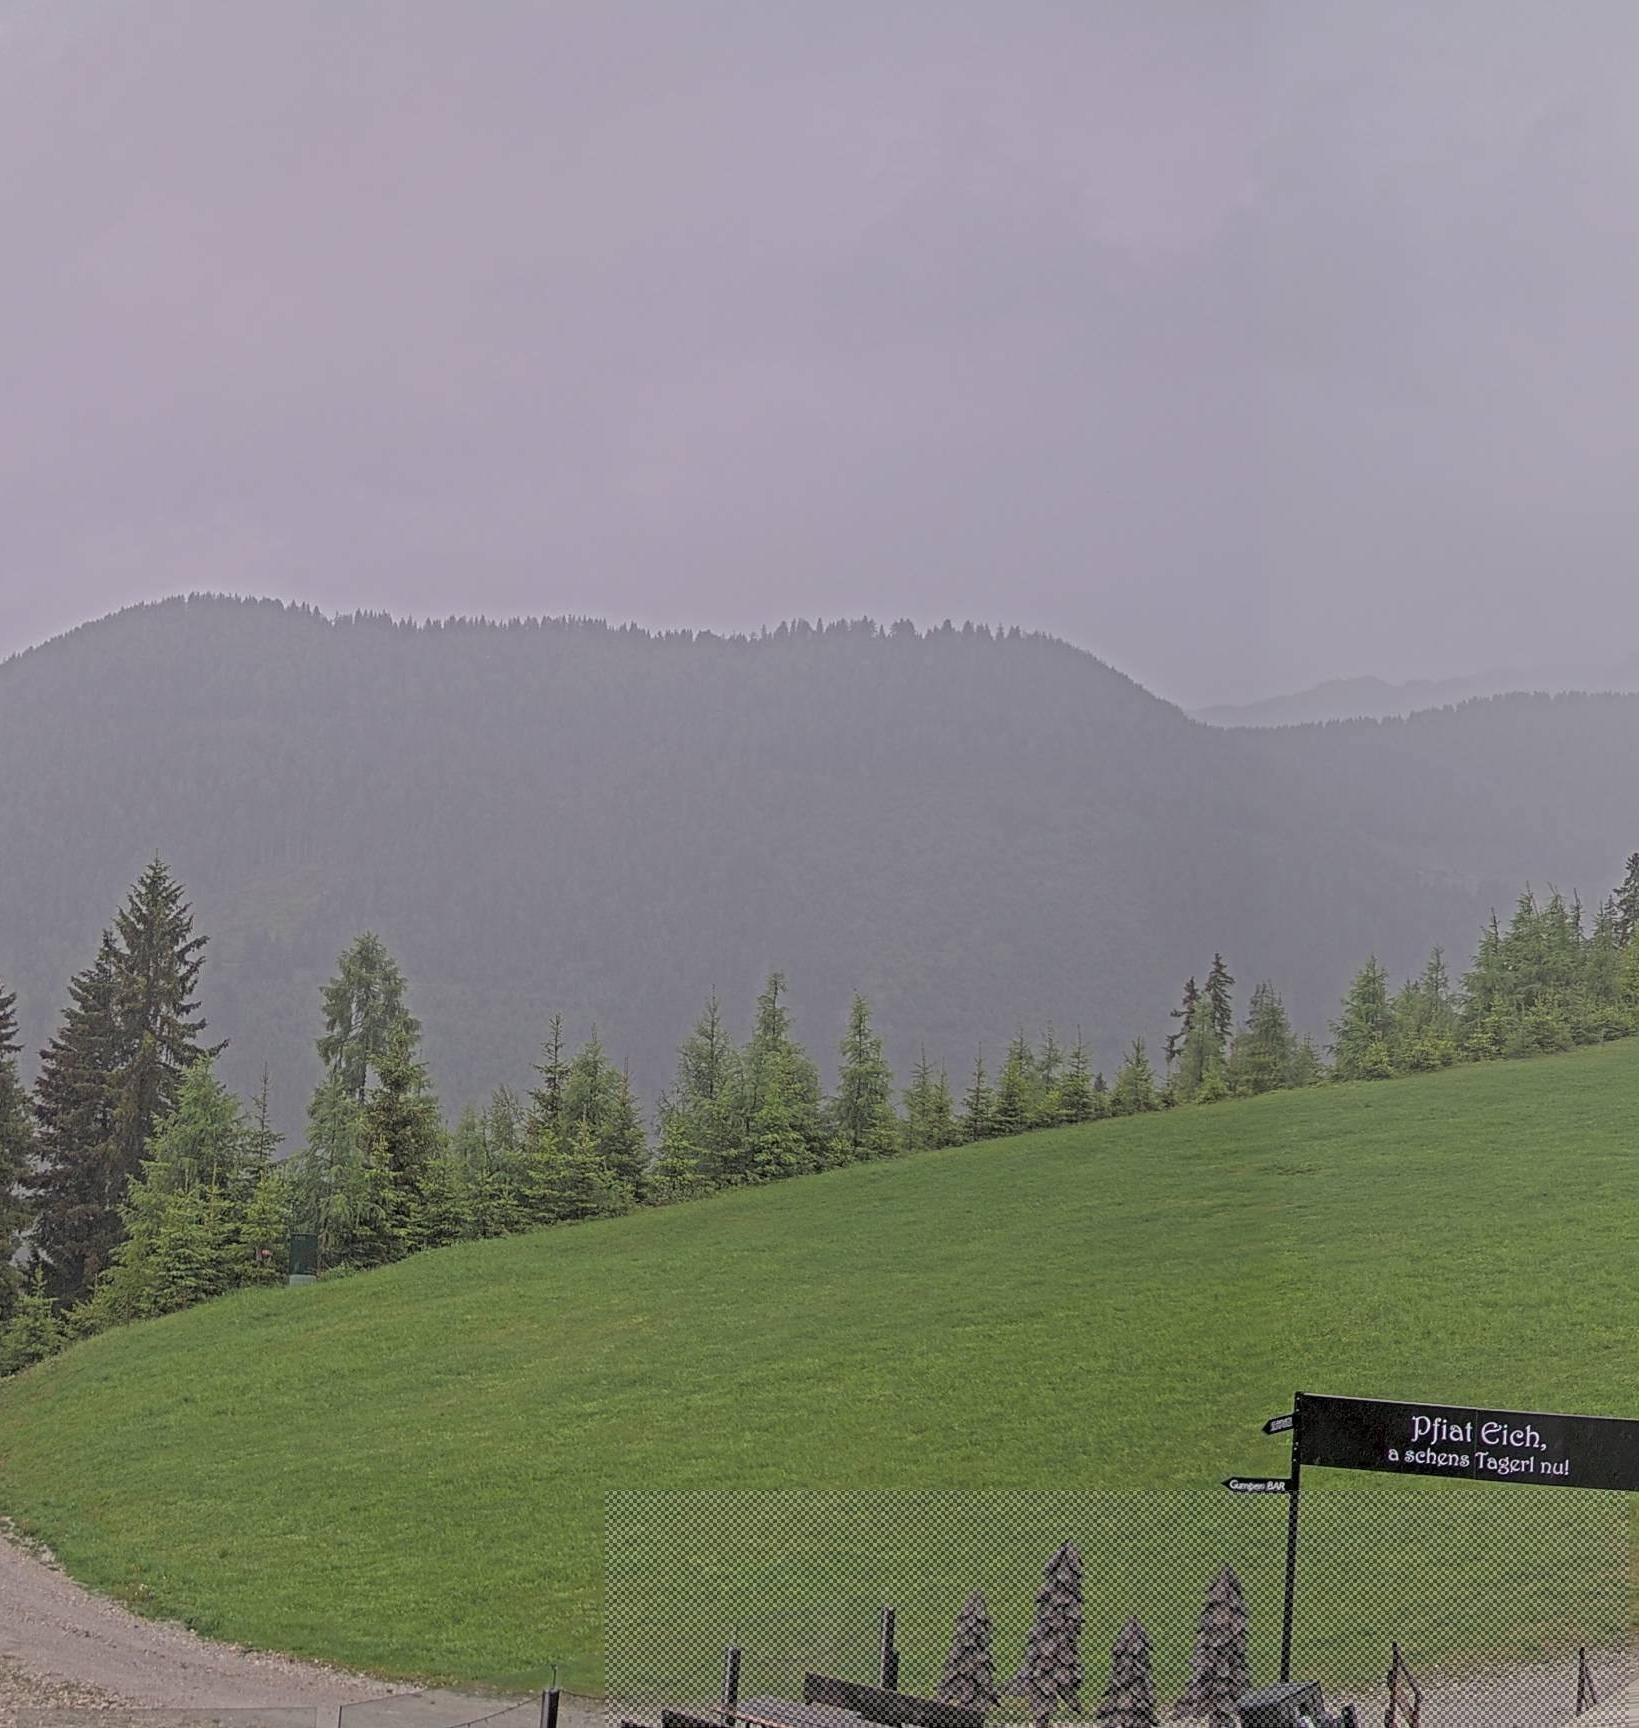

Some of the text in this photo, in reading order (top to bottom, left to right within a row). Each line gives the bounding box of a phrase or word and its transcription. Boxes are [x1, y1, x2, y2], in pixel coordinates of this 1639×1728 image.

[1411, 1415, 1547, 1451] Pfiat Eich,
[1388, 1448, 1570, 1476] a schens Tagerl nu!
[1267, 1480, 1286, 1491] BAR
